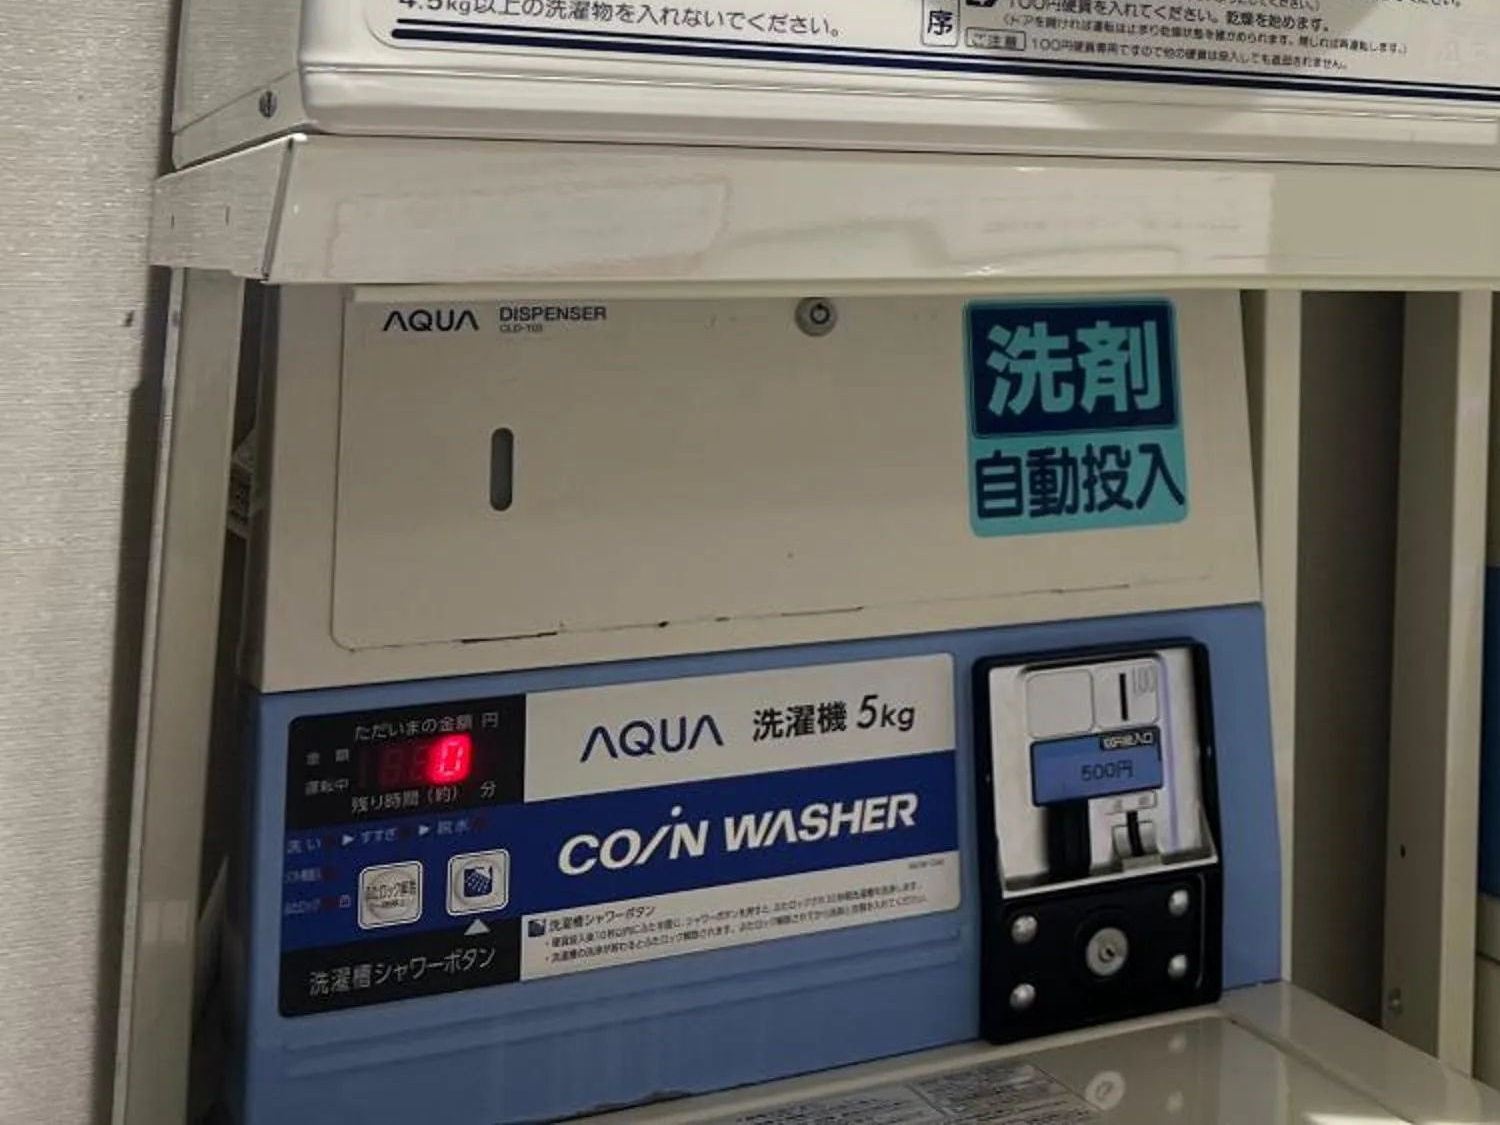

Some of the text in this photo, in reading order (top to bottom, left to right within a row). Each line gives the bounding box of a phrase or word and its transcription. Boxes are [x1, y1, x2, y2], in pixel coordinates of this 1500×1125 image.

[382, 306, 607, 332] AQUA DISPENSER
[986, 320, 1163, 416] 洗剤
[975, 443, 1185, 520] 自動投入
[354, 712, 500, 742] ただいまの金額 円
[578, 693, 916, 764] AQUA 洗濯機 5kg
[438, 739, 465, 778] 0
[1080, 758, 1134, 783] 500円
[480, 780, 496, 799] 分
[724, 792, 919, 852] WASHER
